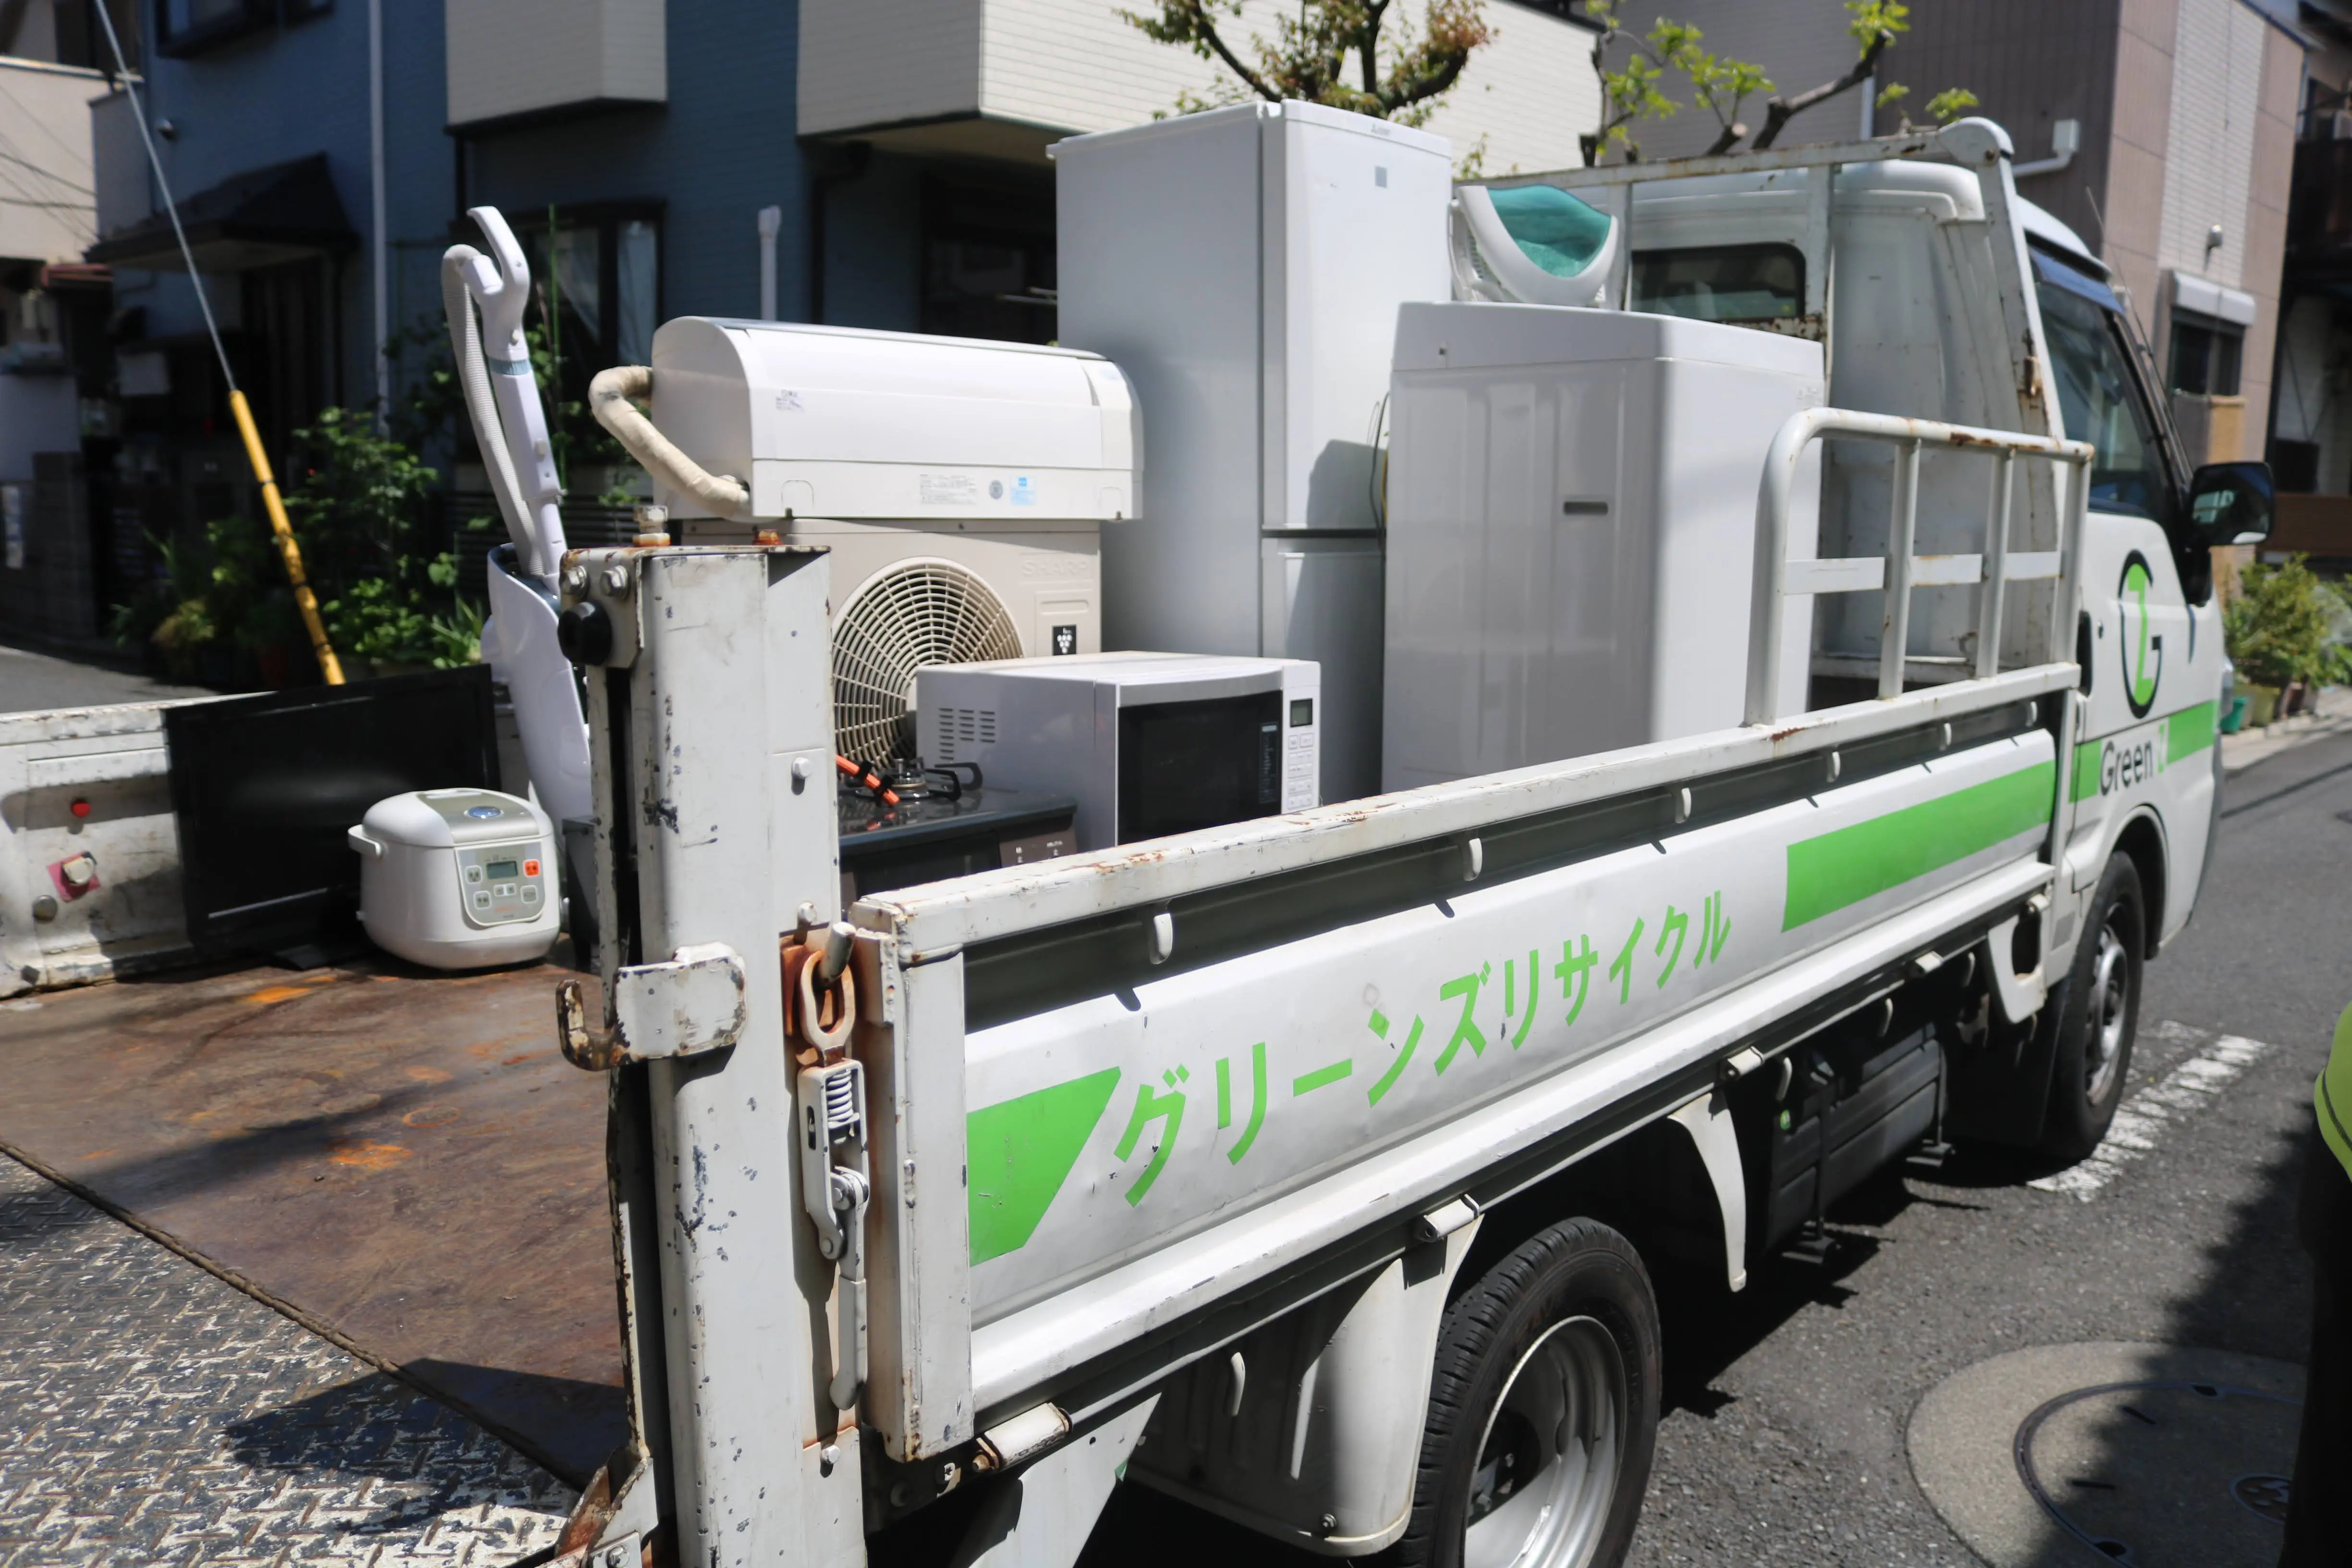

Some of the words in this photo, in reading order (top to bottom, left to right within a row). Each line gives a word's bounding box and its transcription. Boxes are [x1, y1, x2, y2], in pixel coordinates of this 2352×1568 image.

[1022, 560, 1090, 577] SHARP
[2100, 740, 2153, 796] Green
[1114, 890, 1730, 1206] グリーンズリサイクル
